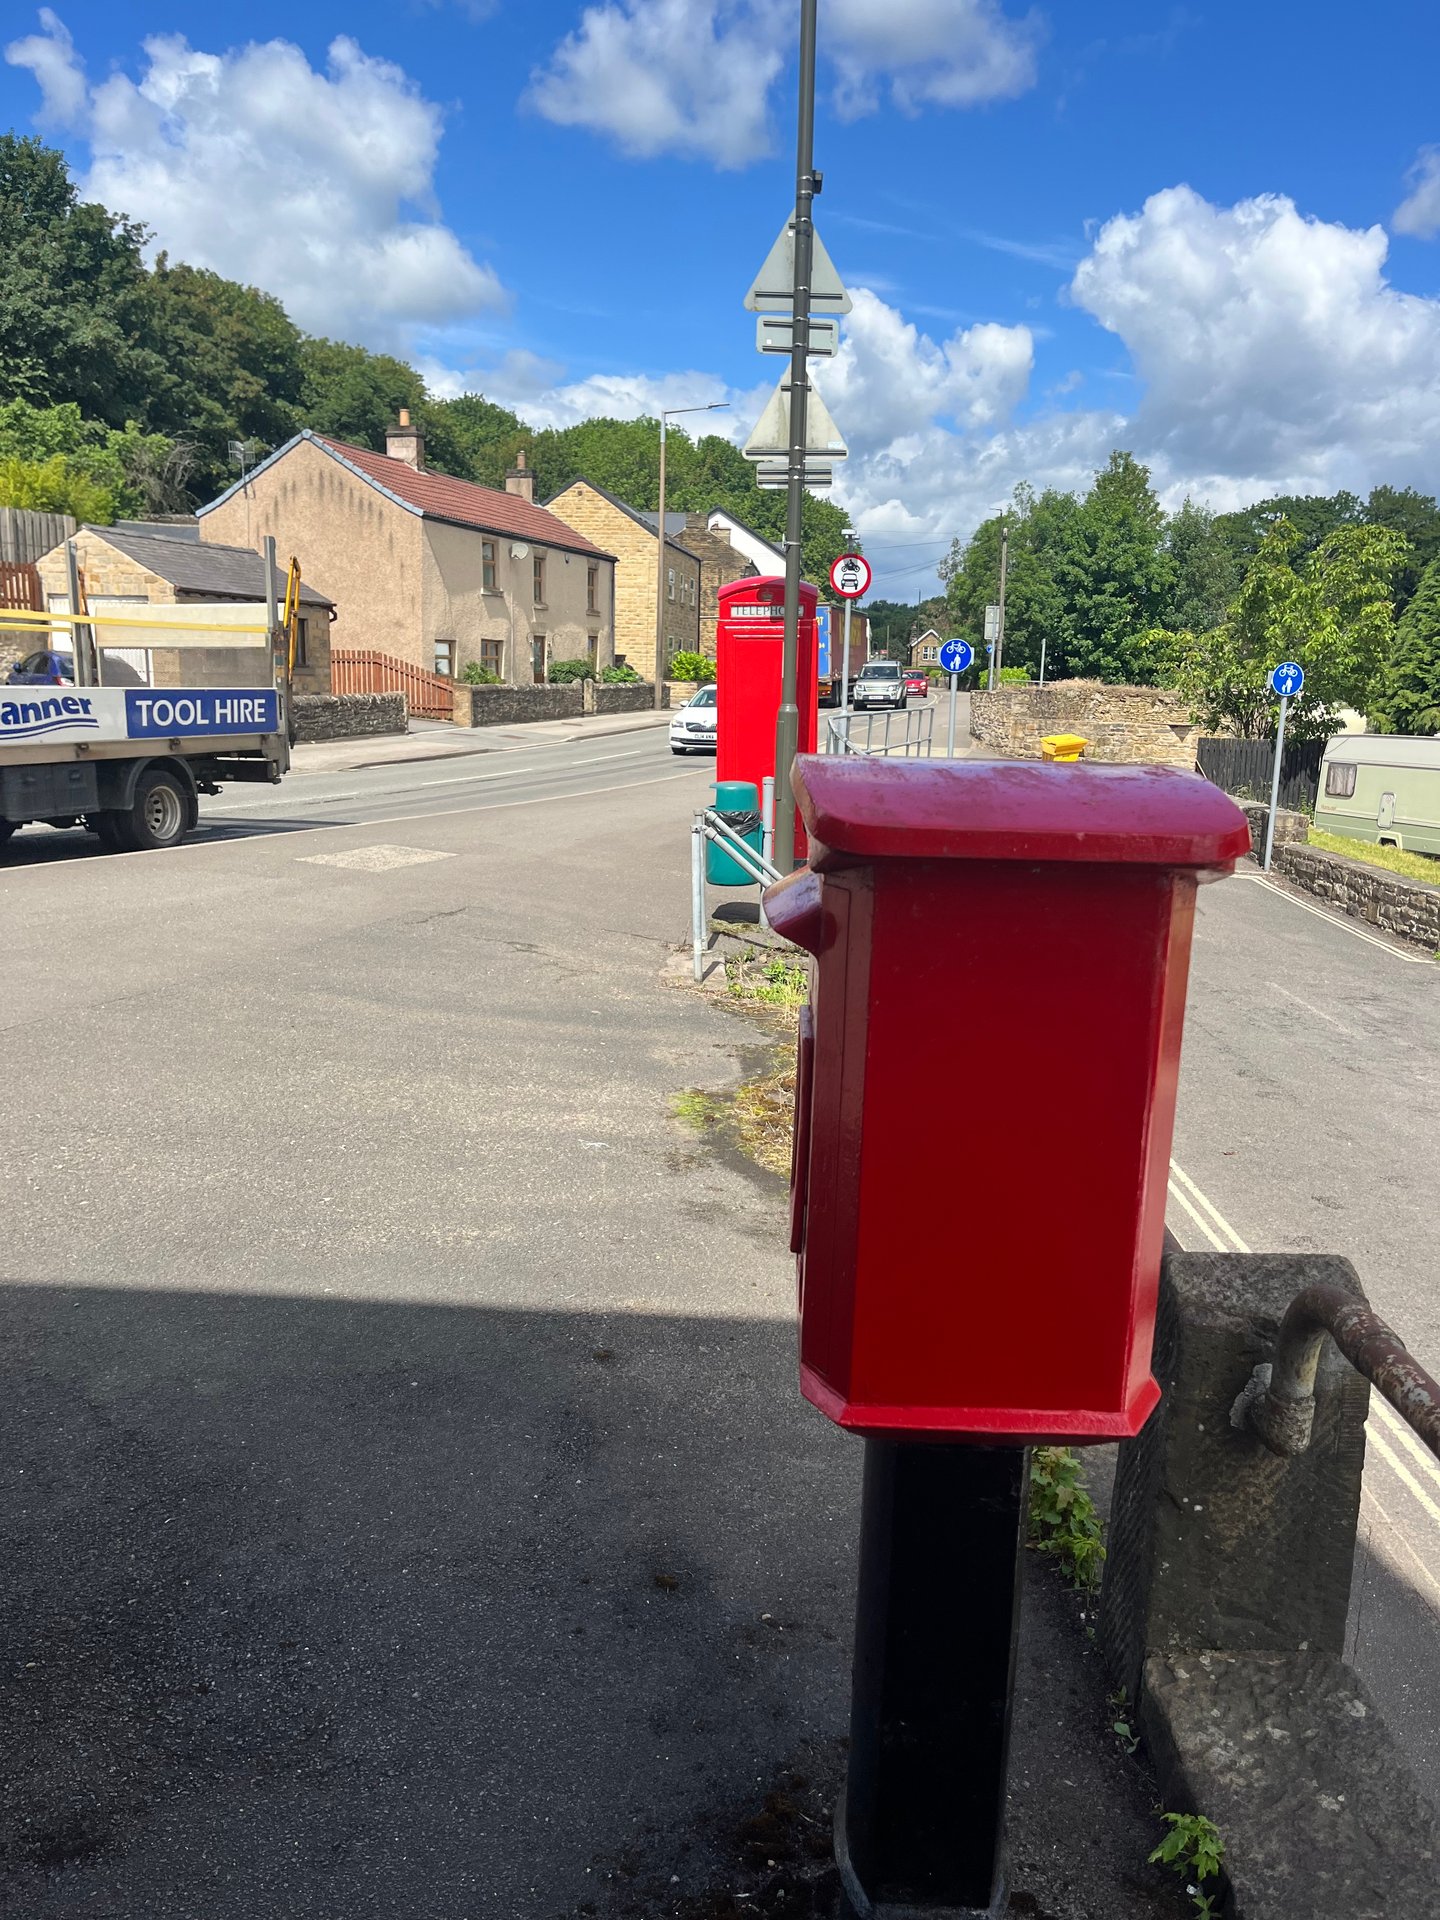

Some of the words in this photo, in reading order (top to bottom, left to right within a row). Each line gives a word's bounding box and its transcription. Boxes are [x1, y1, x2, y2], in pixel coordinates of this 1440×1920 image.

[734, 605, 802, 616] TELEPHOE
[0, 696, 92, 725] anner
[136, 700, 209, 726] TOOL
[215, 699, 266, 724] HIRE
